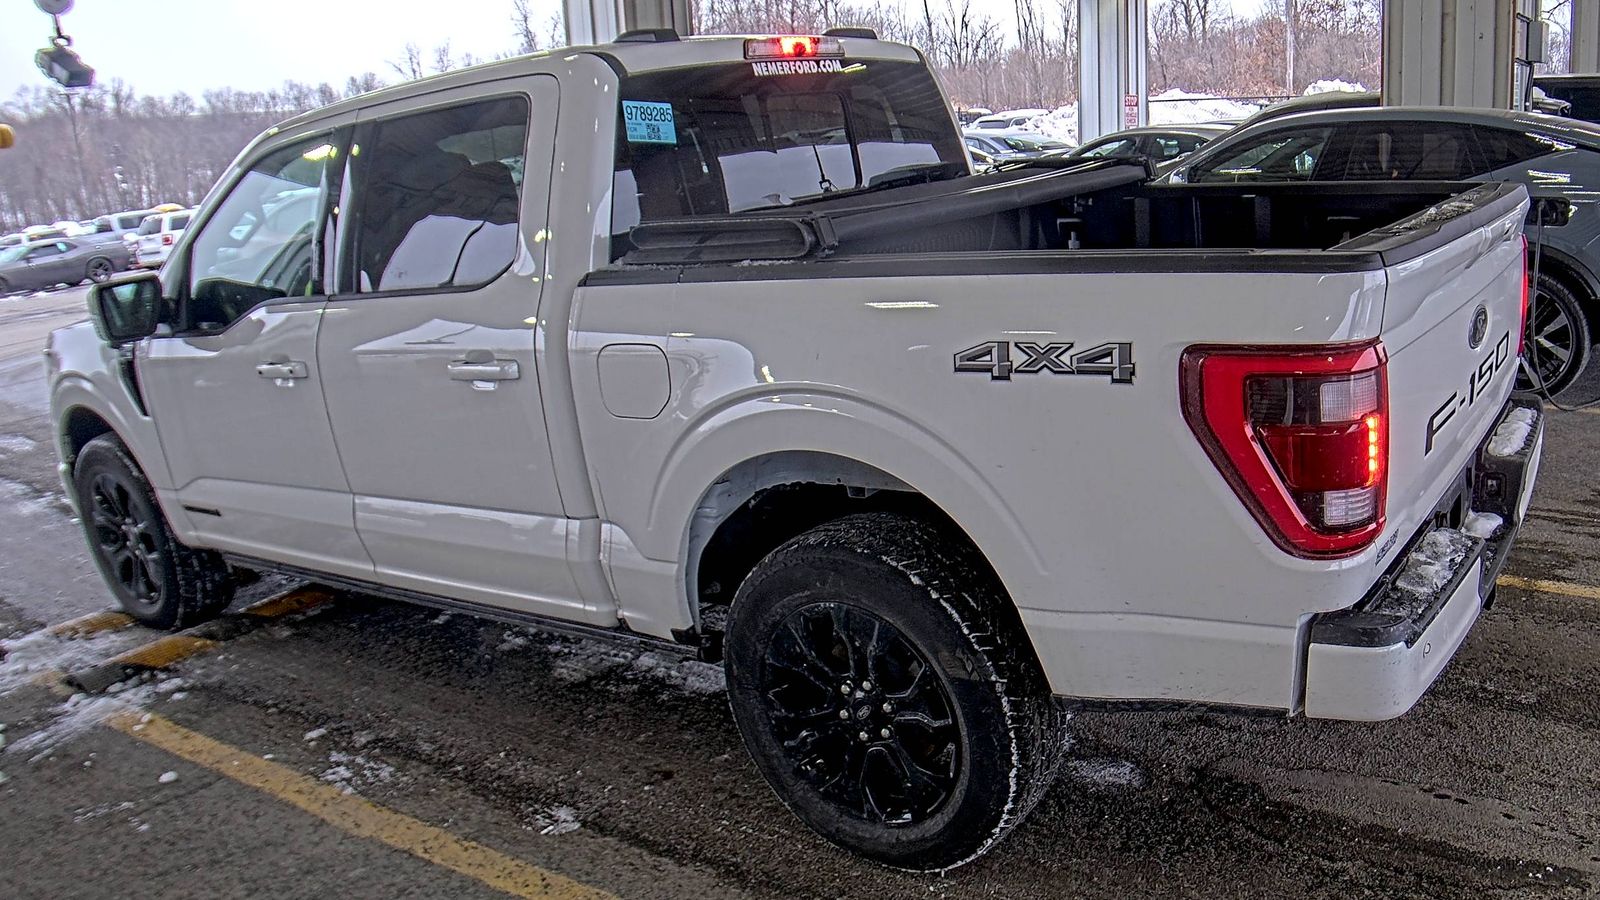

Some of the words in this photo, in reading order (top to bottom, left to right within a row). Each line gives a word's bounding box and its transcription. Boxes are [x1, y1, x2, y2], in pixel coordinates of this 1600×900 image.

[752, 60, 841, 76] NEMERFORD.COM
[1125, 96, 1138, 106] STOP
[625, 105, 672, 122] 9789285
[1424, 330, 1510, 456] F-150
